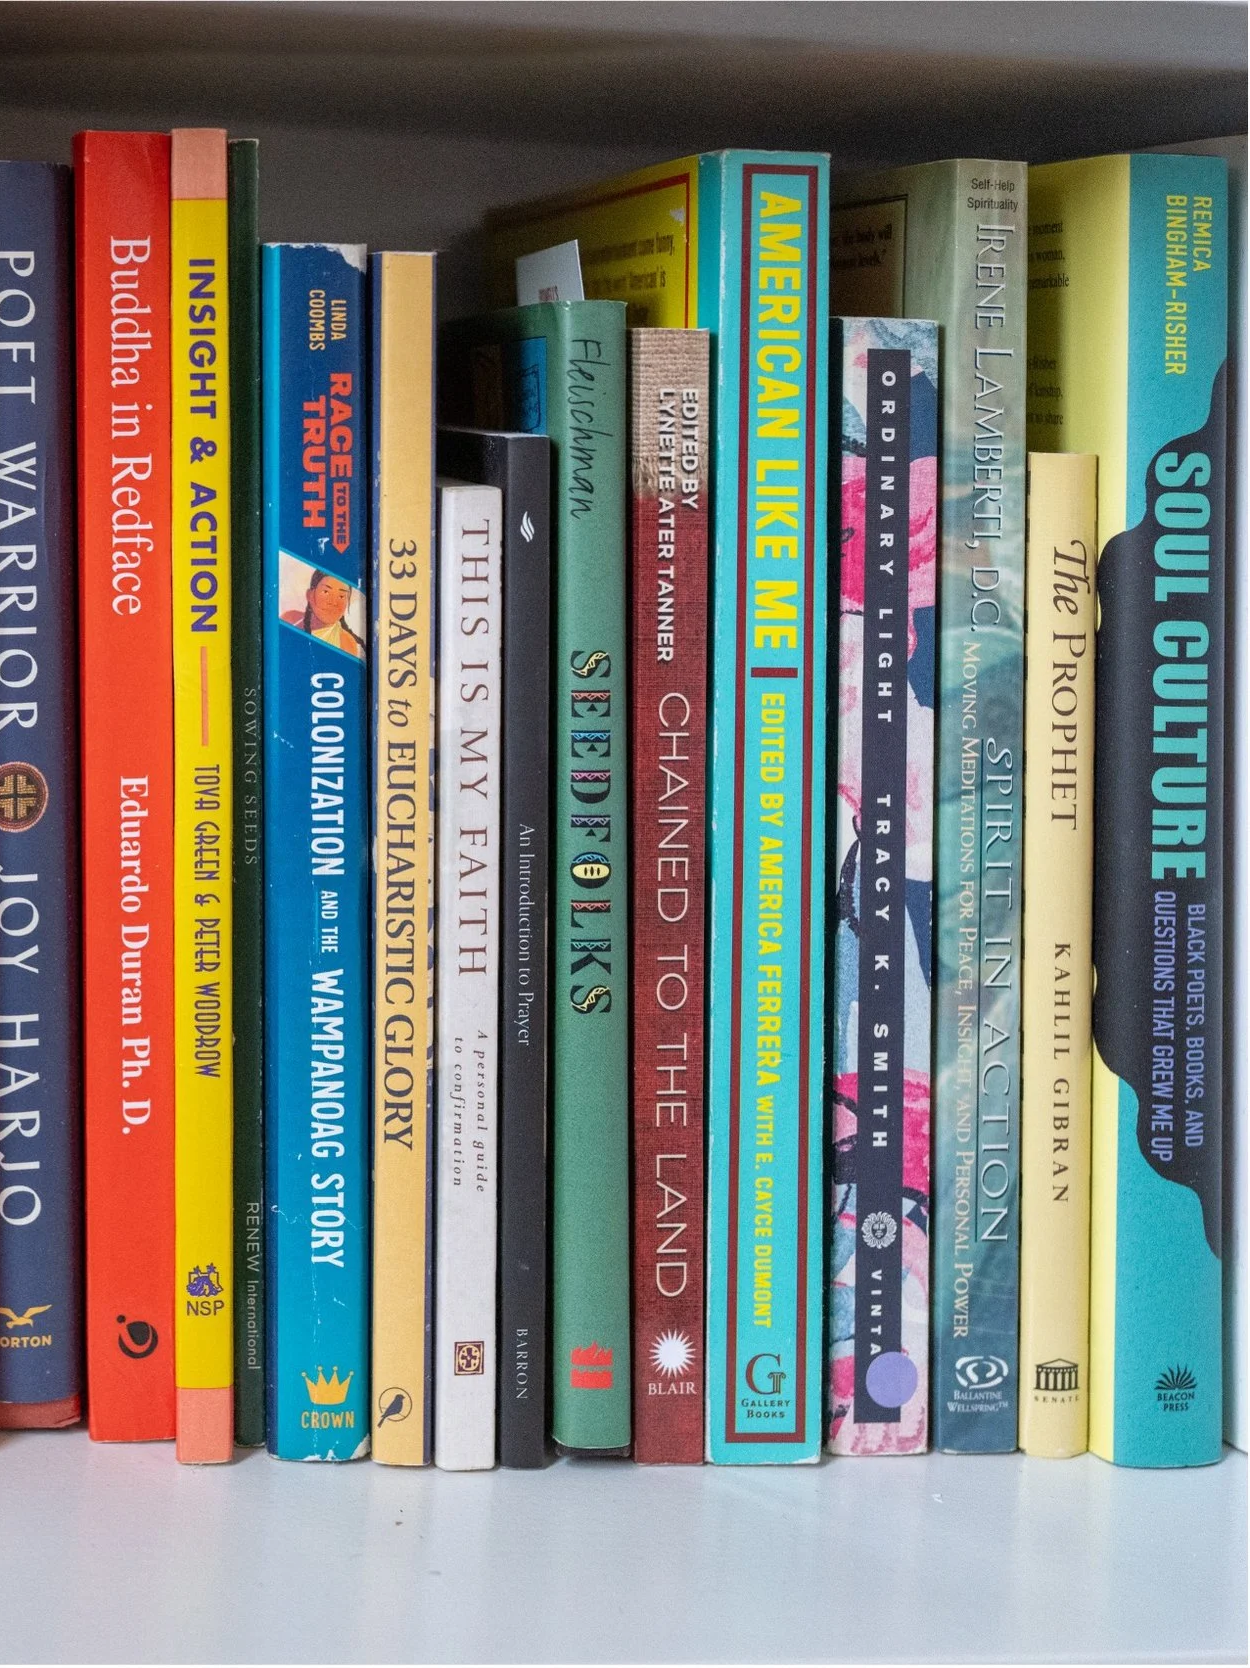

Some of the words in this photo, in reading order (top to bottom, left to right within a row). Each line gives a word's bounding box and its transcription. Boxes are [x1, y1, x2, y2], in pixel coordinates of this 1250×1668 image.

[967, 197, 1019, 213] Spirituality
[971, 178, 1015, 193] Self-Help
[1193, 196, 1213, 272] REMICA
[110, 235, 152, 389] Buddha
[756, 191, 802, 438] AMERICAN
[975, 223, 1016, 330] IRENE
[1165, 194, 1188, 375] BINGHAM-RISHER
[188, 258, 217, 419] INSIGHT
[308, 289, 326, 352] COOMBS
[330, 299, 347, 341] LINDA
[111, 402, 154, 440] in
[189, 436, 217, 464] &
[329, 372, 354, 478] RACE
[566, 339, 613, 520] Fleischman
[658, 388, 676, 493] LYNETTE
[681, 388, 700, 473] EDITED
[965, 348, 1014, 550] LAMBERTI,
[302, 394, 327, 528] TRUTH
[336, 486, 347, 506] TO
[681, 480, 699, 510] BY
[879, 371, 897, 576] ORDINARY
[111, 453, 154, 616] Redface
[336, 511, 347, 545] THE
[657, 497, 675, 560] ATER
[755, 459, 799, 559] LIKE
[1153, 451, 1211, 602] SOUL
[189, 481, 218, 633] ACTION
[388, 538, 417, 581] 33
[1053, 538, 1091, 616] The
[657, 566, 675, 663] TANNER
[754, 580, 798, 649] ME
[971, 566, 1000, 632] D.C.
[387, 591, 418, 689] DAYS
[877, 608, 893, 722] LIGHT
[244, 687, 257, 782] SOWING
[387, 697, 413, 728] to
[760, 693, 786, 783] EDITED
[1051, 630, 1086, 831] PROPHET
[1151, 620, 1210, 880] CULTURE
[310, 672, 345, 877] COLONIZATION
[657, 692, 690, 923] CHAINED
[759, 792, 785, 827] BY
[244, 796, 258, 865] SEEDS
[519, 824, 535, 847] An
[570, 650, 612, 1014] SEEDFOLKS
[875, 794, 891, 921] TRACY
[985, 737, 1014, 911] SPIRIT
[319, 890, 339, 920] AND
[384, 740, 417, 1006] EUCHARISTIC
[518, 853, 535, 961] Introduction
[757, 835, 784, 956] AMERICA
[320, 926, 339, 954] THE
[518, 967, 531, 985] to
[656, 944, 688, 1011] TO
[873, 954, 890, 991] K.
[983, 937, 1013, 991] IN
[1153, 890, 1176, 992] QUESTIONS
[478, 1030, 488, 1039] A
[513, 992, 534, 1046] Prayer
[756, 964, 782, 1087] FERRERA
[1053, 942, 1071, 1060] KAHLIL
[1152, 997, 1175, 1039] THAT
[310, 968, 345, 1159] WAMPANOAG
[383, 1013, 415, 1151] GLORY
[455, 1037, 463, 1053] to
[656, 1032, 688, 1128] THE
[1151, 1044, 1174, 1107] GREW
[450, 1063, 466, 1186] confirmation
[473, 1050, 488, 1131] personal
[755, 1094, 774, 1146] WITH
[872, 1023, 889, 1148] SMITH
[1152, 1111, 1174, 1136] ME
[473, 1141, 488, 1193] guide
[754, 1152, 774, 1170] E.
[980, 1019, 1011, 1244] ACTION
[1052, 1077, 1070, 1203] GIBRAN
[1151, 1139, 1173, 1162] UP
[246, 1202, 261, 1272] RENEW
[310, 1173, 345, 1269] STORY
[656, 1154, 688, 1298] LAND
[753, 1176, 774, 1238] CAYCE
[186, 1299, 225, 1317] NSP
[246, 1280, 261, 1370] International
[753, 1244, 773, 1329] DUMONT
[516, 1328, 528, 1399] BARRON
[648, 1382, 698, 1395] BLAIR
[953, 1390, 1002, 1400] BALLANTINE
[1034, 1393, 1080, 1402] SENATE
[1157, 1392, 1195, 1402] BEACON
[301, 1410, 355, 1429] CROWN
[741, 1398, 791, 1408] GALLERY
[746, 1410, 786, 1419] BOOKS
[1163, 1402, 1189, 1411] PRESS
